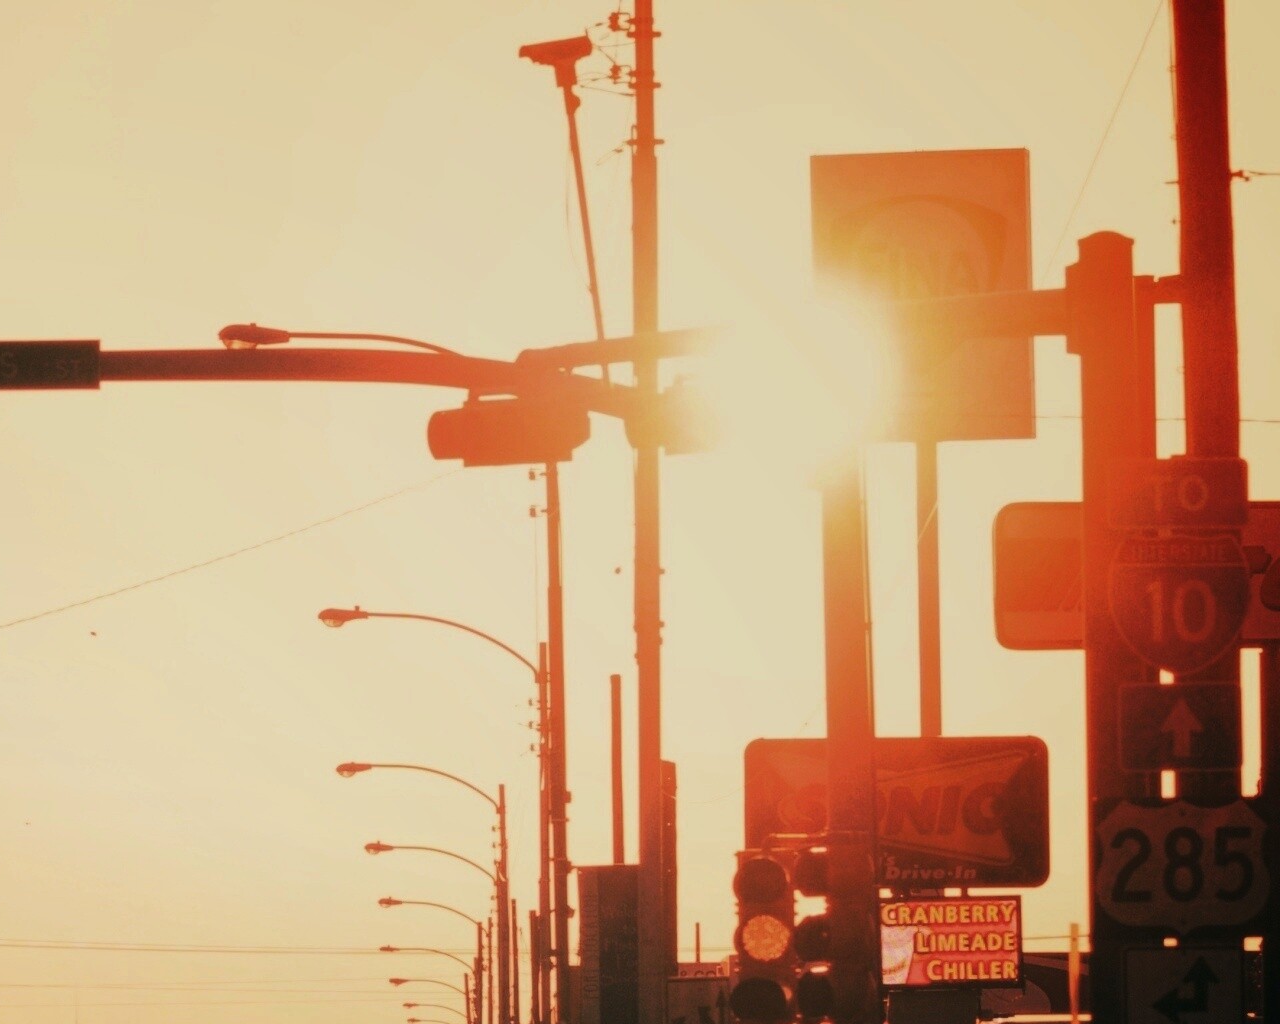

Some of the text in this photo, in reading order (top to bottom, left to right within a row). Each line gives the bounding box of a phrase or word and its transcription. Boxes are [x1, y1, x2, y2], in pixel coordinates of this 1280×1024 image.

[1146, 473, 1210, 512] TO
[1146, 578, 1217, 643] 10
[777, 782, 1003, 836] SNIC
[1110, 826, 1255, 903] 285
[881, 903, 1016, 926] CRANBERRY
[915, 932, 1017, 953] LIMEADE
[926, 959, 1017, 980] CHILLER
